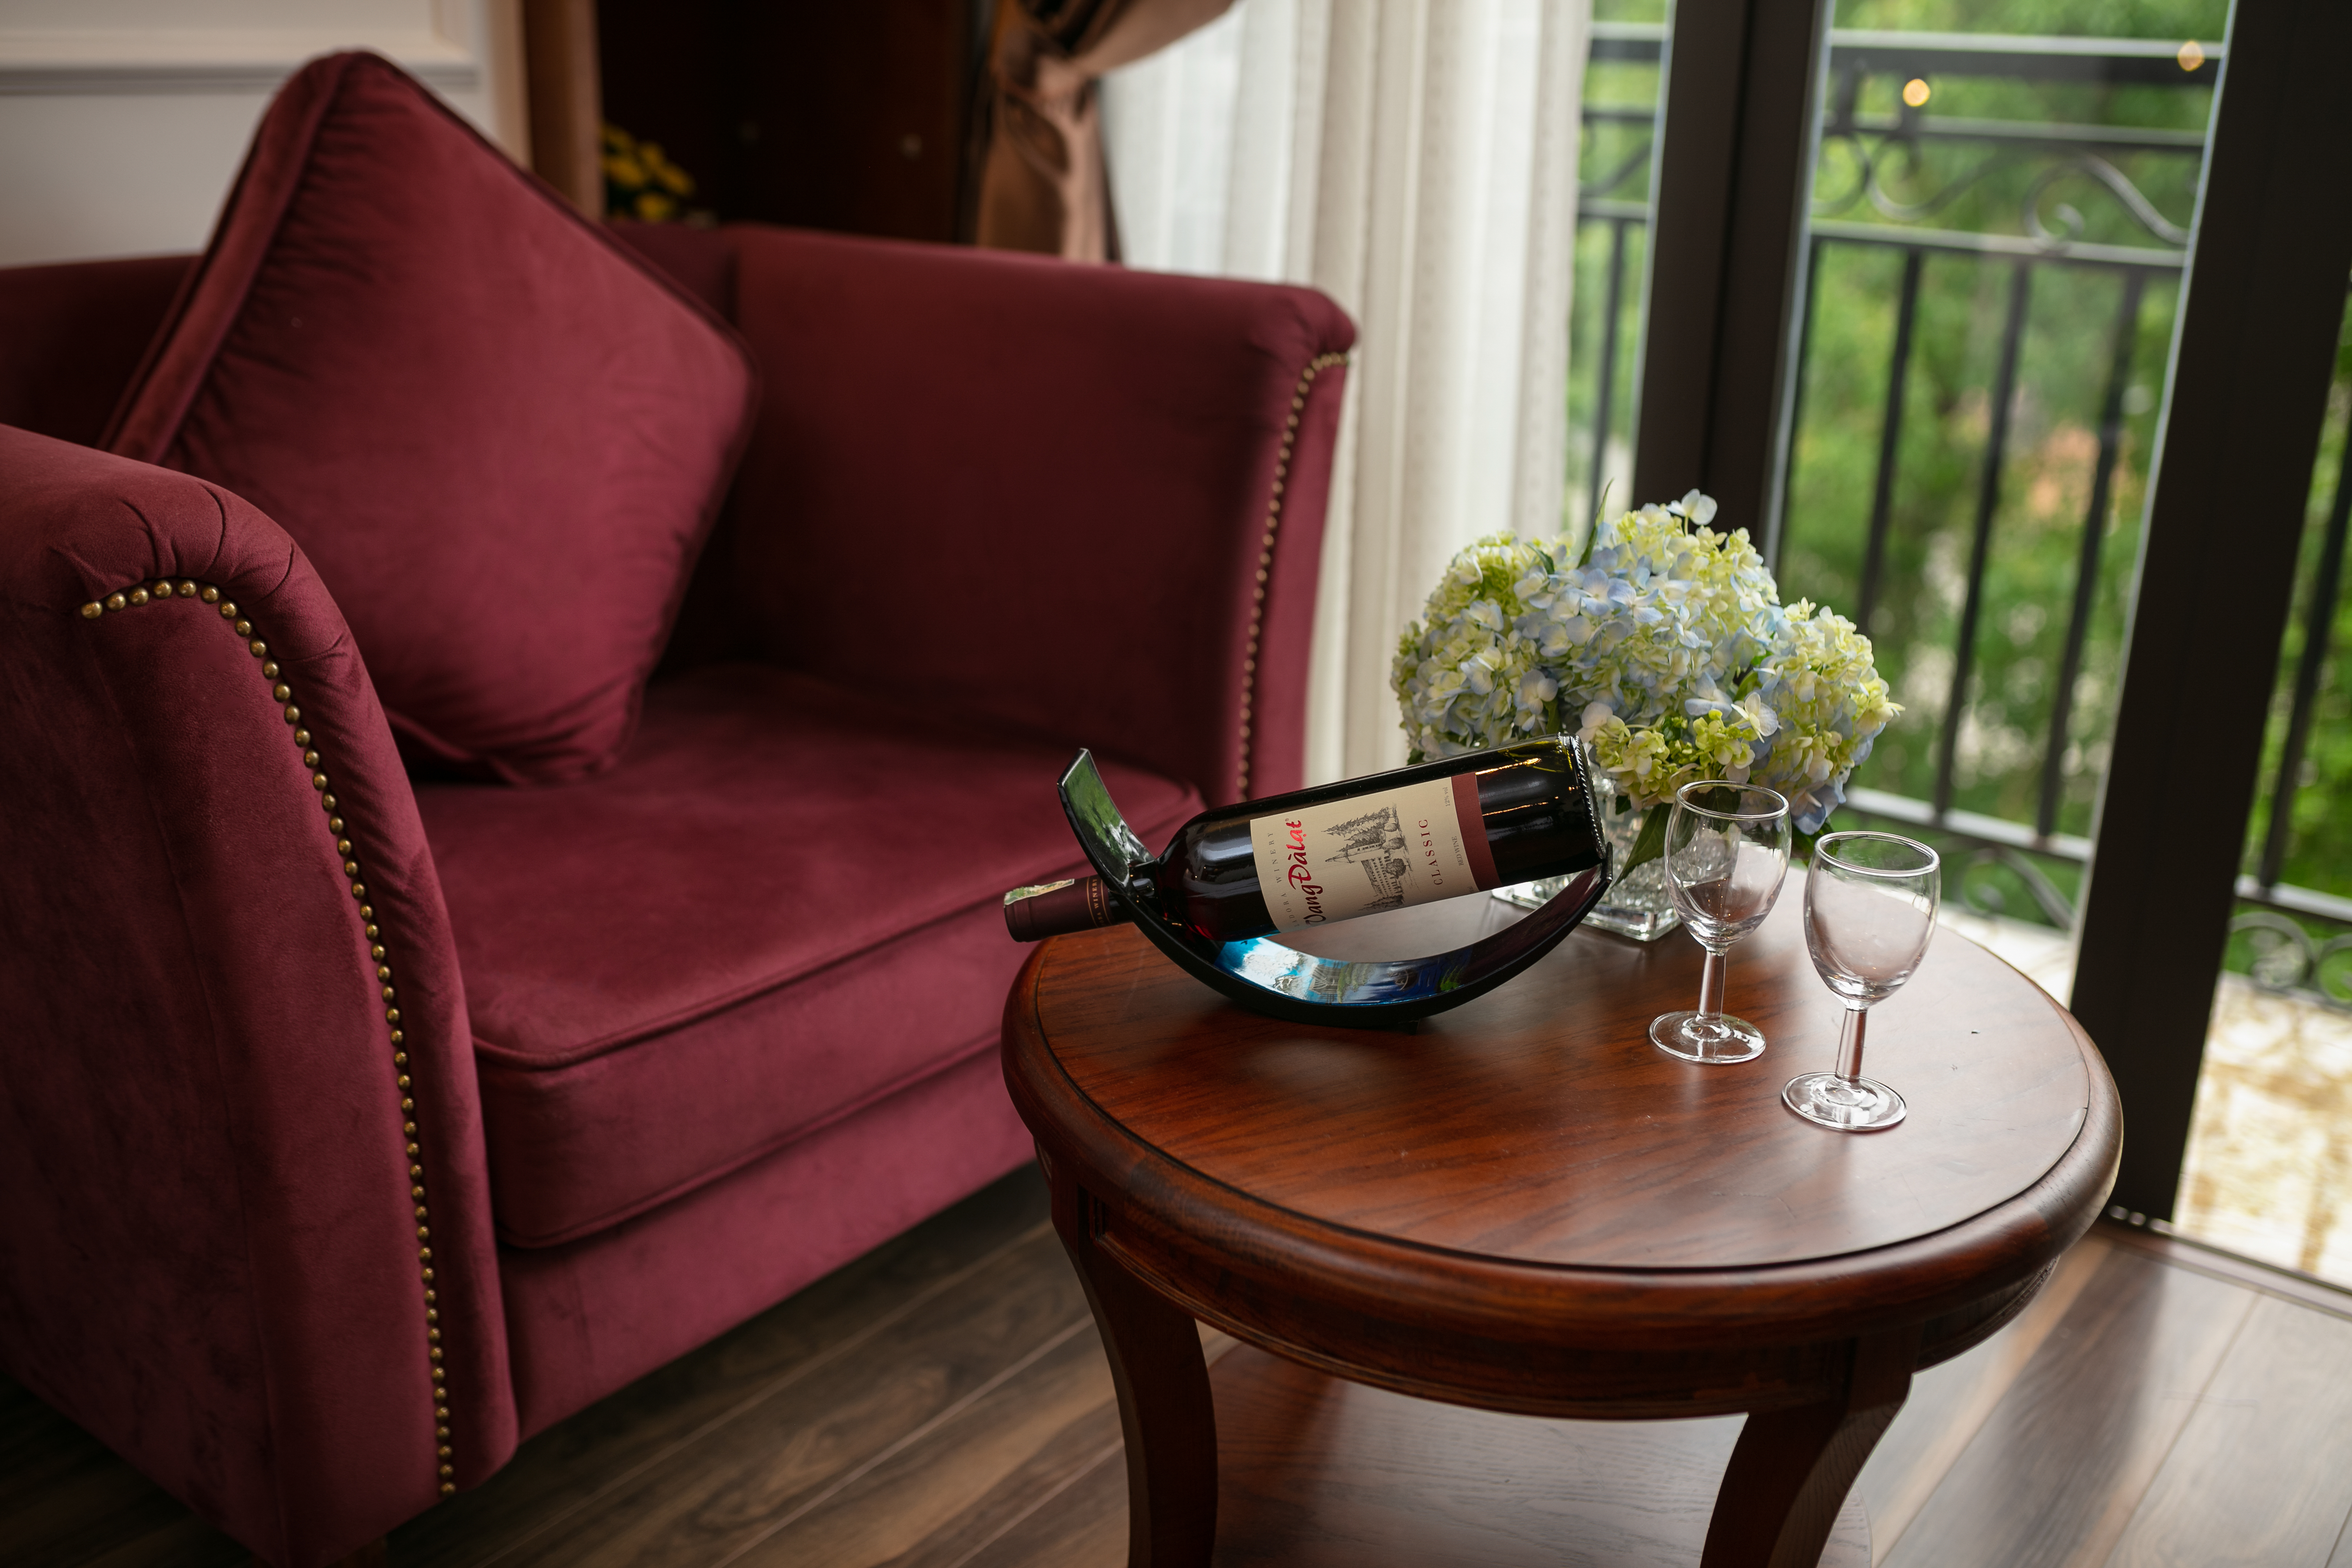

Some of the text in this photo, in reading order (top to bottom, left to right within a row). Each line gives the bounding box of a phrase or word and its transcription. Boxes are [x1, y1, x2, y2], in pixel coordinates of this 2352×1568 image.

[1418, 819, 1443, 885] CLASSIC
[1451, 836, 1460, 853] WINE
[1267, 833, 1299, 927] LADORA WINERY
